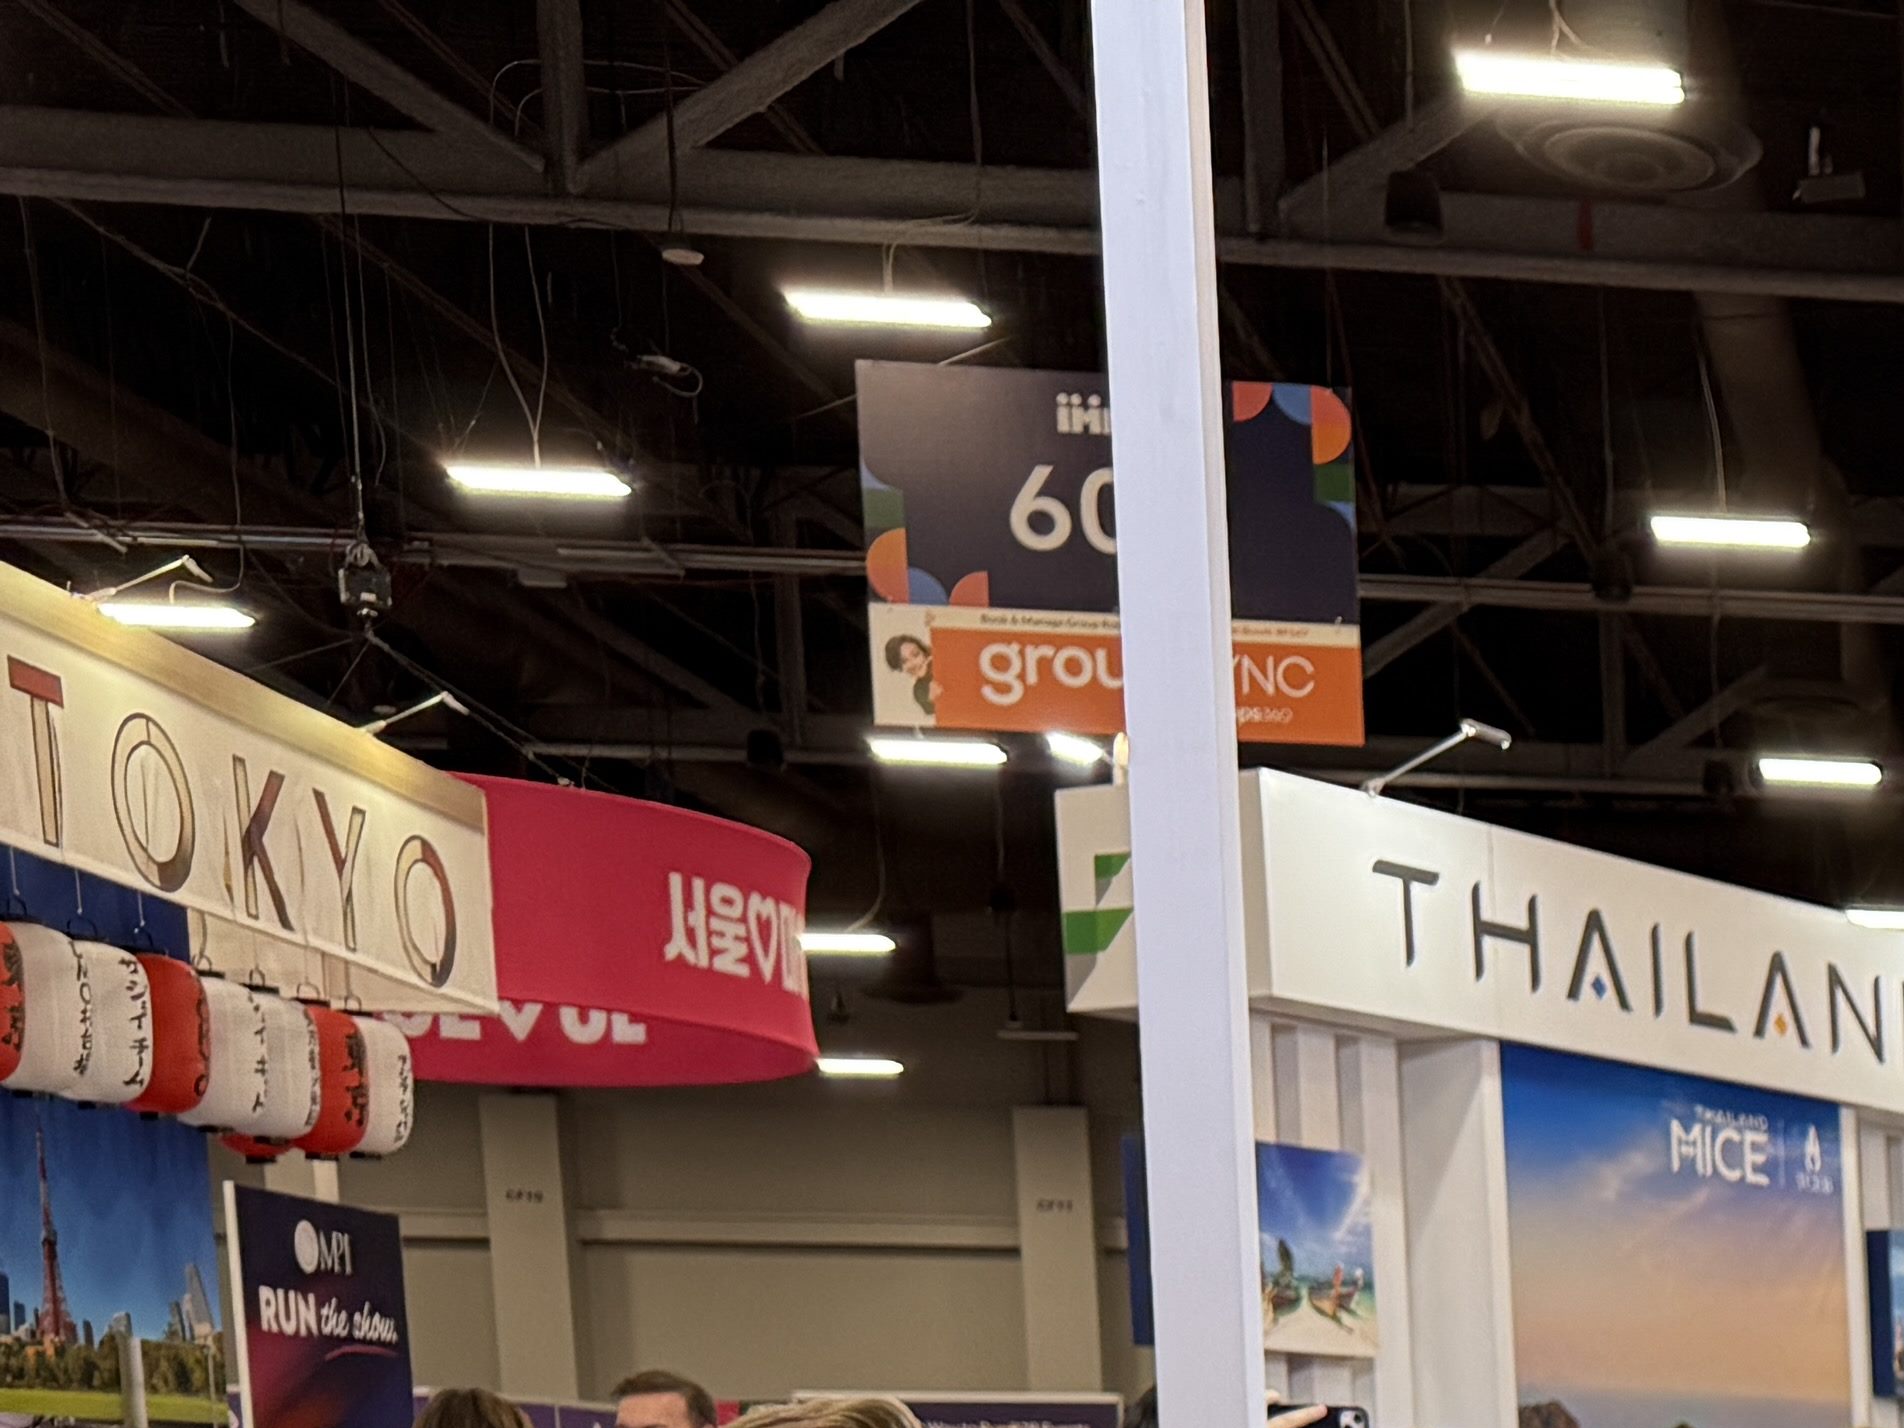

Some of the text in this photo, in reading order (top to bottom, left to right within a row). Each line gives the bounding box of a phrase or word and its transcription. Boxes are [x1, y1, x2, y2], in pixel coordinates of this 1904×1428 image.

[7, 655, 458, 988] TOKYO
[1670, 1118, 1770, 1187] MICE
[258, 1285, 319, 1338] RUN
[320, 1298, 349, 1337] the
